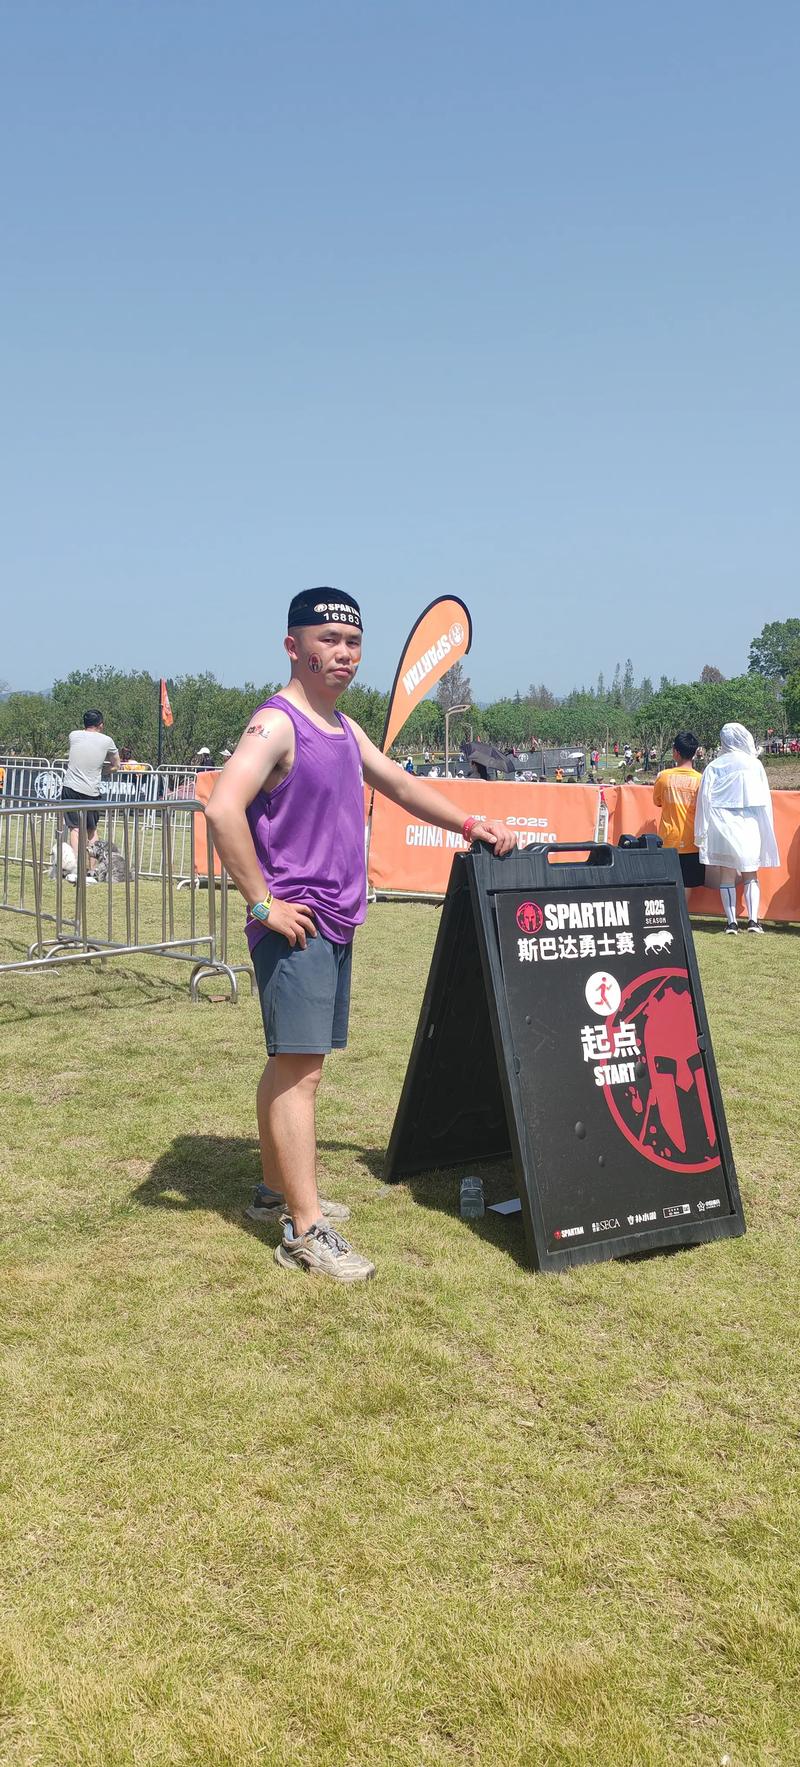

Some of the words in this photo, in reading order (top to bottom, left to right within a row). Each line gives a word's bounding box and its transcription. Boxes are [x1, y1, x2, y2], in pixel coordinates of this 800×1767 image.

[323, 612, 360, 625] 16883
[402, 634, 451, 696] SPARTAN
[505, 816, 549, 828] 2025
[406, 825, 443, 848] CHINA
[544, 900, 630, 931] SPARTAN
[644, 899, 666, 916] 2025
[645, 917, 667, 925] SEASON
[517, 932, 636, 962] 斯巴达勇士赛
[580, 1020, 641, 1063] 起点
[593, 1061, 636, 1087] START
[561, 1226, 584, 1238] SPARTAN
[600, 1218, 620, 1231] SECA
